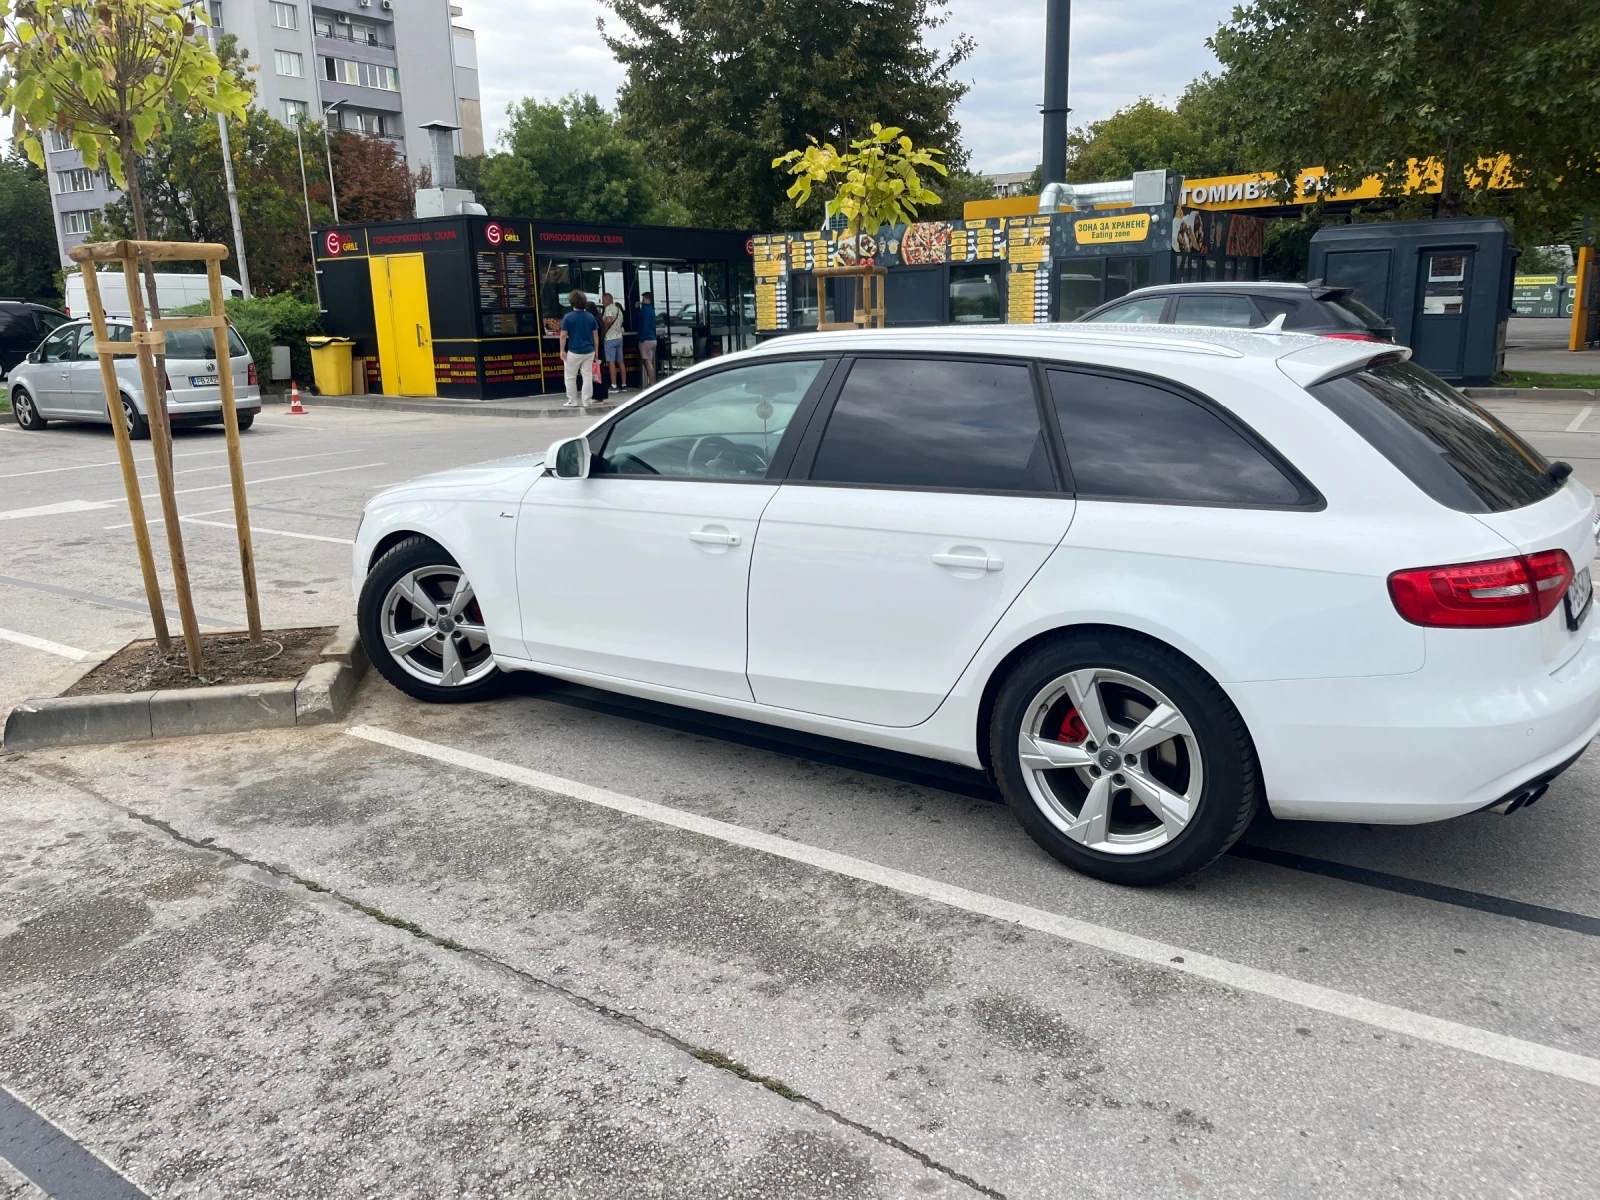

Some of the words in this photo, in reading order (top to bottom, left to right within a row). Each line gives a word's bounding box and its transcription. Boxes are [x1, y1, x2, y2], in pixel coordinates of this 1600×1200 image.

[1180, 177, 1291, 205] ТОМИВ
[1078, 224, 1098, 232] ЗОНА
[1100, 222, 1110, 230] ЗА
[1112, 220, 1146, 230] ХРАНЕНЕ
[434, 231, 456, 240] СКАРА
[504, 234, 520, 242] GRILL
[1092, 231, 1112, 239] Eating
[342, 242, 359, 252] GRILL
